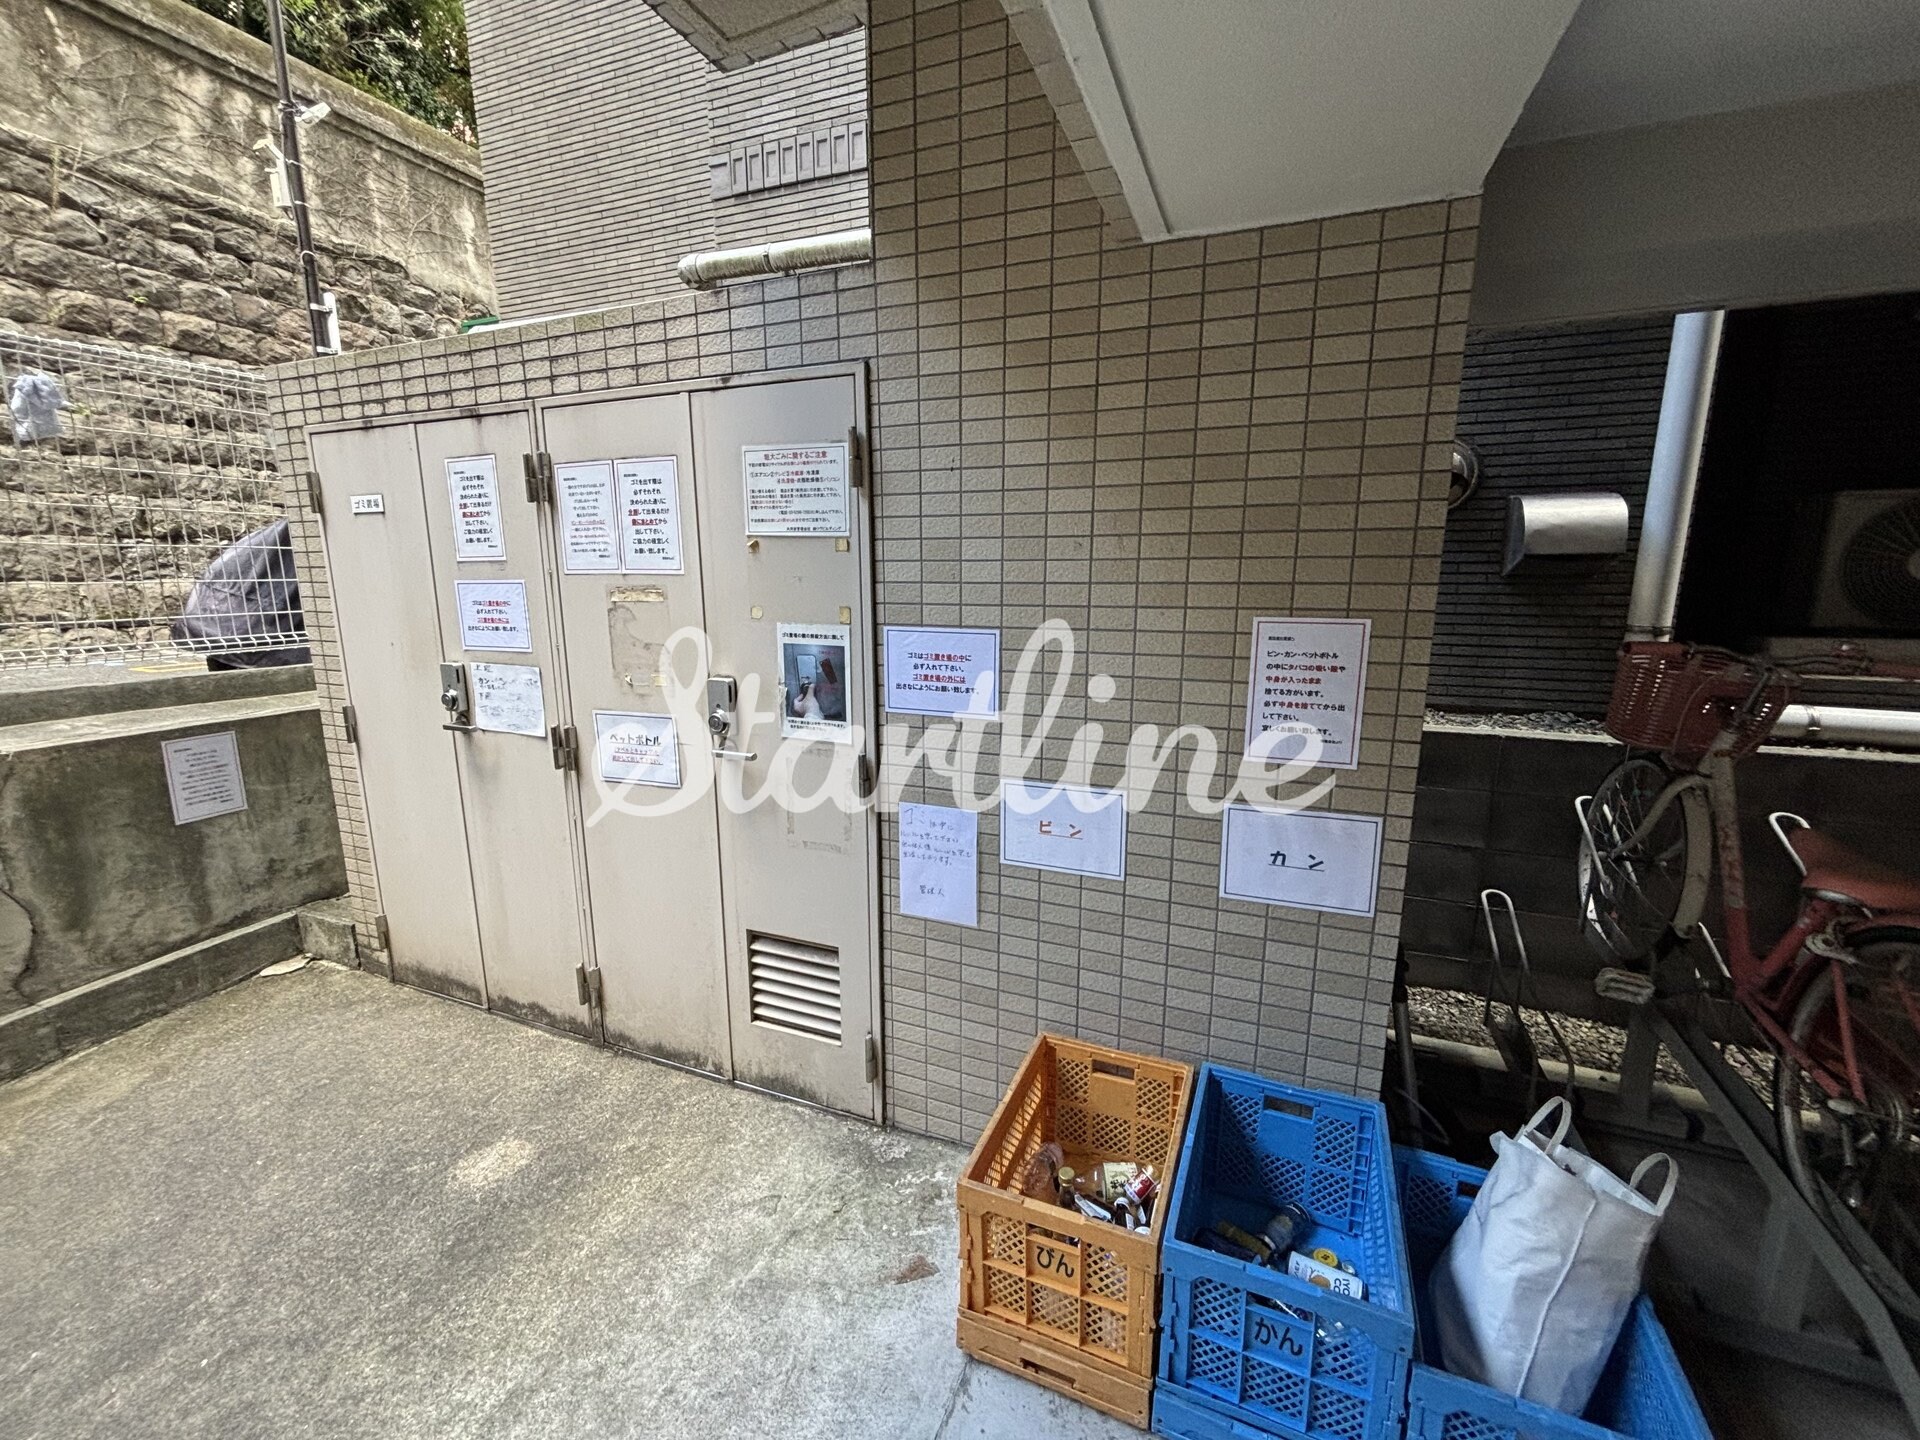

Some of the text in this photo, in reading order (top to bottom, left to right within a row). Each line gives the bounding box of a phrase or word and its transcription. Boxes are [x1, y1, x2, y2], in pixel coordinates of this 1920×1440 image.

[354, 498, 380, 509] ゴミ置場
[907, 652, 972, 662] ゴミはゴミ置き場の中に
[1267, 650, 1339, 659] ビン・カン・ペットボトル
[913, 663, 965, 673] 必ず入れて下さい。
[912, 673, 966, 684] ゴミ置き場の外には
[1265, 675, 1322, 685] 中身が入ったまま
[1264, 687, 1324, 698] 捨てる方がいます。
[1263, 700, 1346, 712] 必ず中身を捨ててから出
[1262, 711, 1299, 721] して下さい。
[610, 732, 661, 746] ペットボトル
[1039, 820, 1082, 838] ビン
[1270, 850, 1324, 870] カン
[1036, 1245, 1074, 1278] びん
[1254, 1316, 1303, 1356] かん
